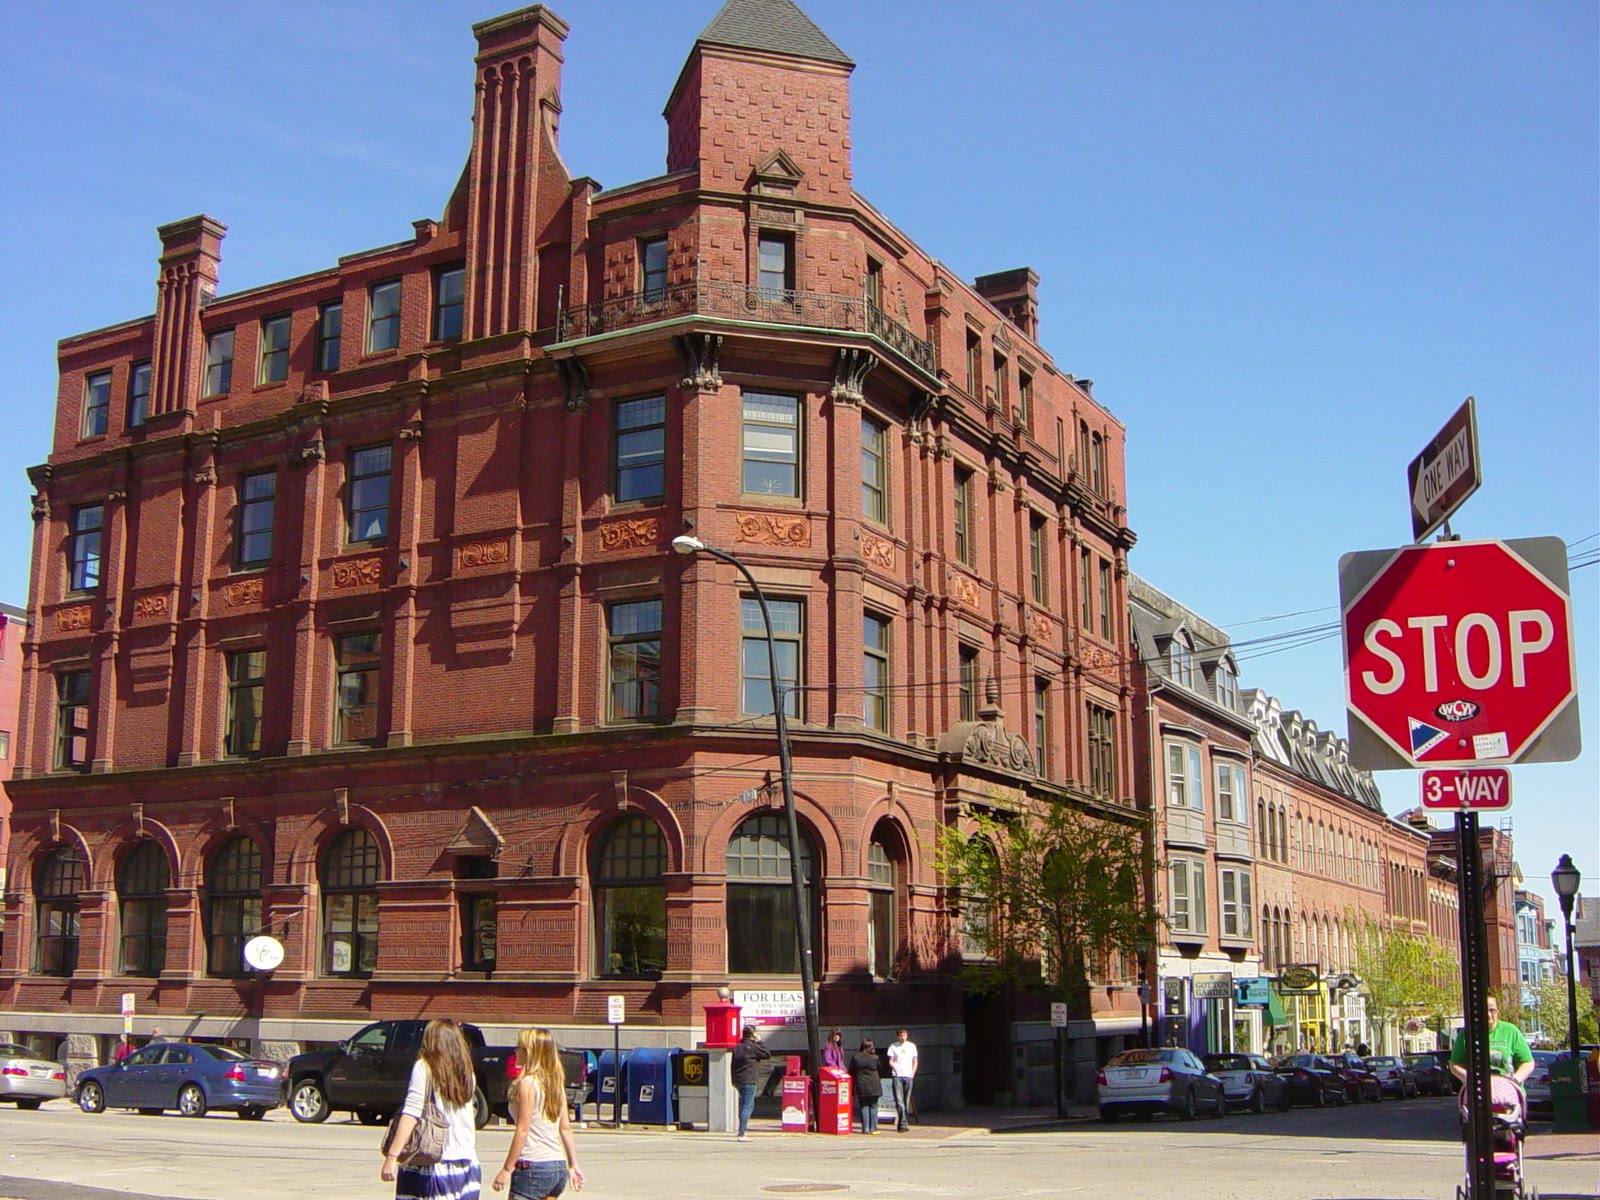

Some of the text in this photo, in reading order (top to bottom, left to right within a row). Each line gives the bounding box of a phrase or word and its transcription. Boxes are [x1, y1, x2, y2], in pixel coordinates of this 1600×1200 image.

[1423, 432, 1466, 503] ONE WAY
[1361, 609, 1555, 695] STOP
[1426, 775, 1504, 802] 3-WAY
[743, 993, 803, 1003] FOR LEAS
[1195, 988, 1229, 996] GARDEN
[685, 1063, 702, 1079] ups
